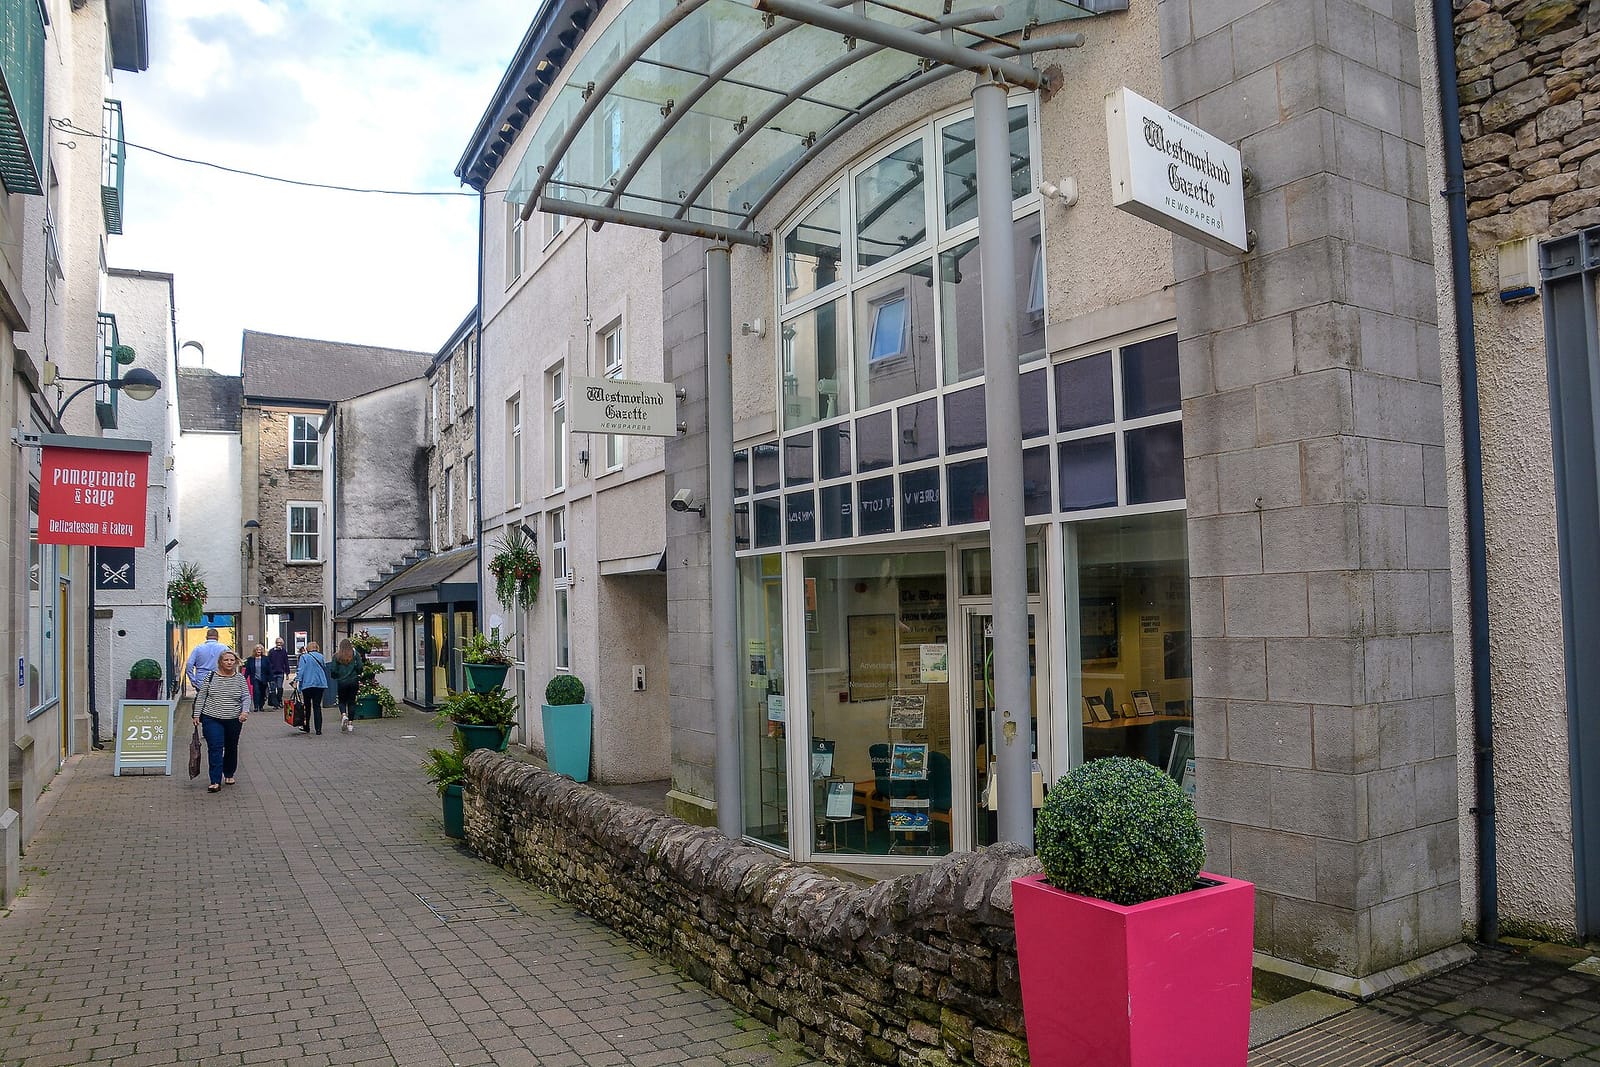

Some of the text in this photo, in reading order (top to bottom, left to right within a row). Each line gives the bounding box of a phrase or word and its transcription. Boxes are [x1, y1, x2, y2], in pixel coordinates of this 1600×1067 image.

[1142, 116, 1231, 186] Westmorland
[1168, 162, 1216, 209] Gazette
[1165, 196, 1222, 230] NEWSPAPERS
[586, 386, 664, 406] Westmorland
[605, 404, 648, 420] Gazette
[600, 423, 651, 431] NEWSPAPERS
[74, 488, 81, 504] &
[49, 519, 99, 534] Delicatessen
[110, 523, 134, 537] Eatery
